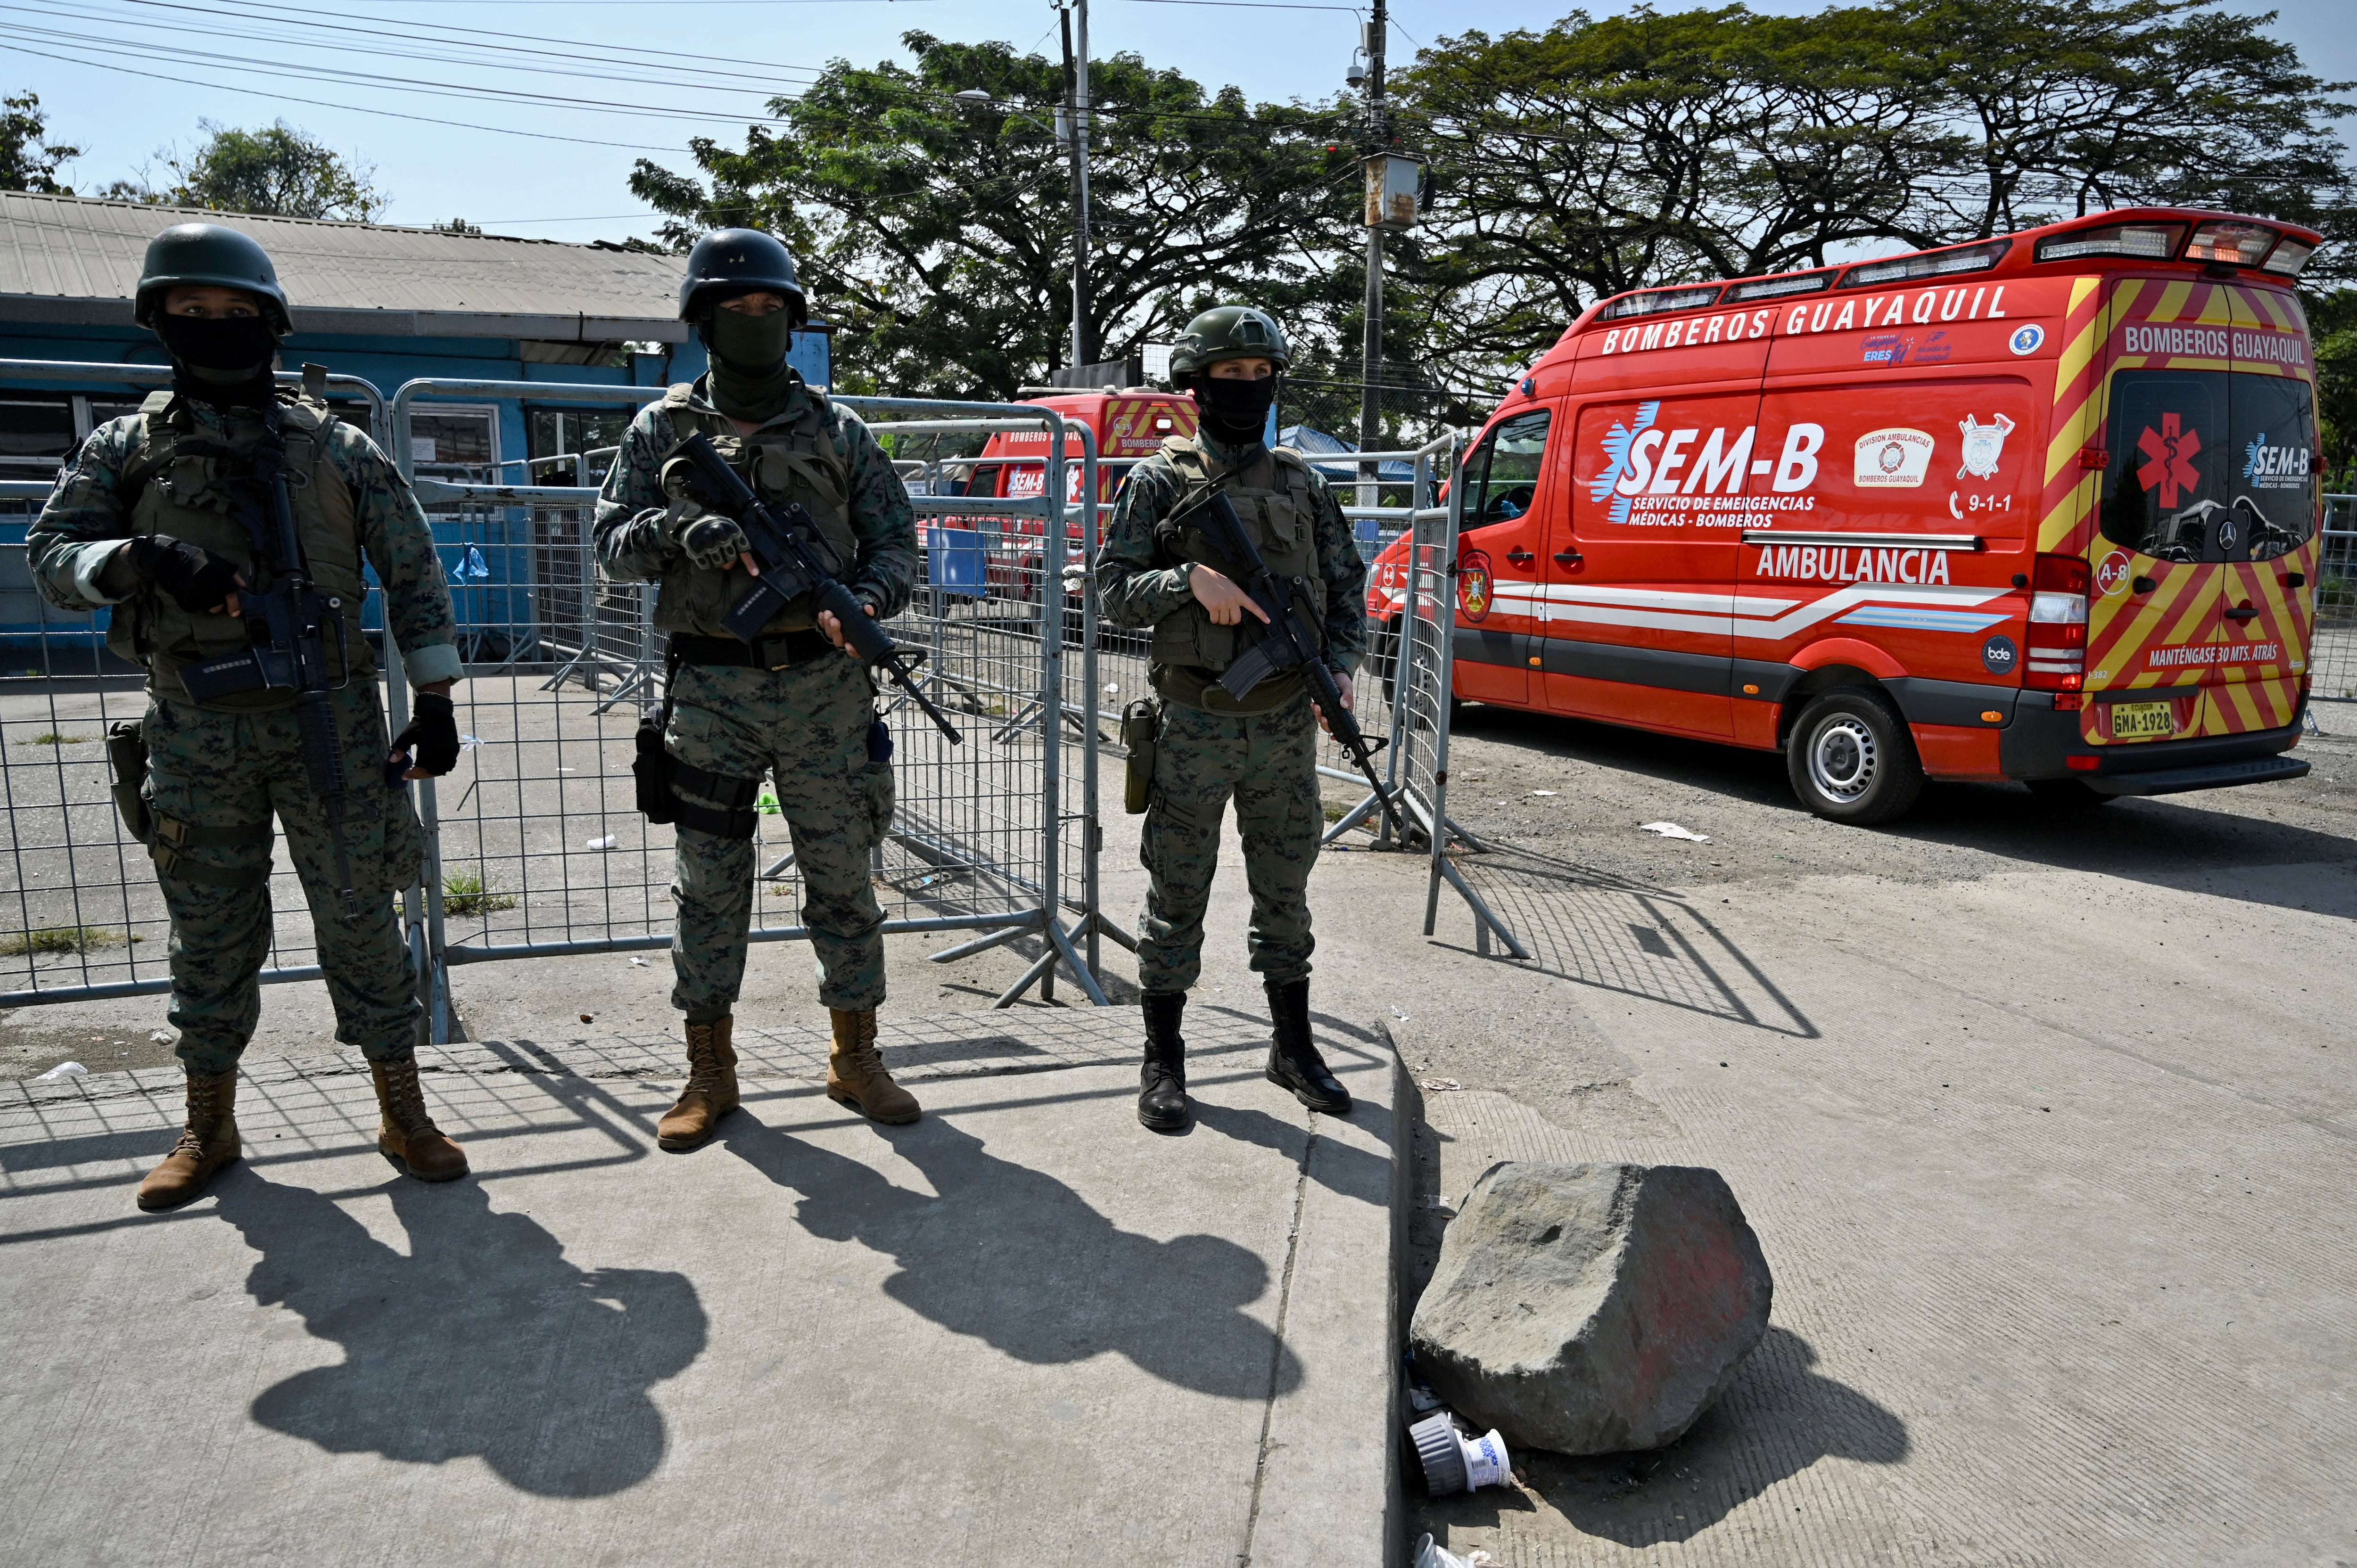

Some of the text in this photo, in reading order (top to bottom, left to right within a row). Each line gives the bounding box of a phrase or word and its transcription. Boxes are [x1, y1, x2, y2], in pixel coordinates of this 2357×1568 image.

[1603, 286, 2005, 355] BOMBEROS GUAYAQUIL
[2126, 327, 2304, 365] BOMBEROS GUAYAQUIL
[1863, 350, 1892, 361] ERES
[1010, 432, 1047, 443] BOMBEROS
[1859, 433, 1930, 449] DIVISION AMBULANCIAS
[1616, 423, 1824, 496] SEM-B
[2253, 446, 2308, 475] SEM-B
[1012, 473, 1045, 491] SEM-B
[1633, 496, 1814, 511] SERVICIO DE EMERGENCIAS
[1969, 494, 2011, 511] 9-1-1
[1629, 511, 1685, 527] MÉDICAS
[1696, 513, 1772, 528] BOMBEROS
[1756, 545, 1949, 585] AMBULANCIA
[2100, 564, 2127, 581] A-8
[1384, 571, 1393, 580] A-8
[1988, 646, 2011, 660] bde
[2149, 641, 2277, 667] MANTÉNGASE 30 MTS. ATRÁS
[2131, 703, 2153, 711] ECUADOR
[2114, 712, 2171, 733] GMA-1928
